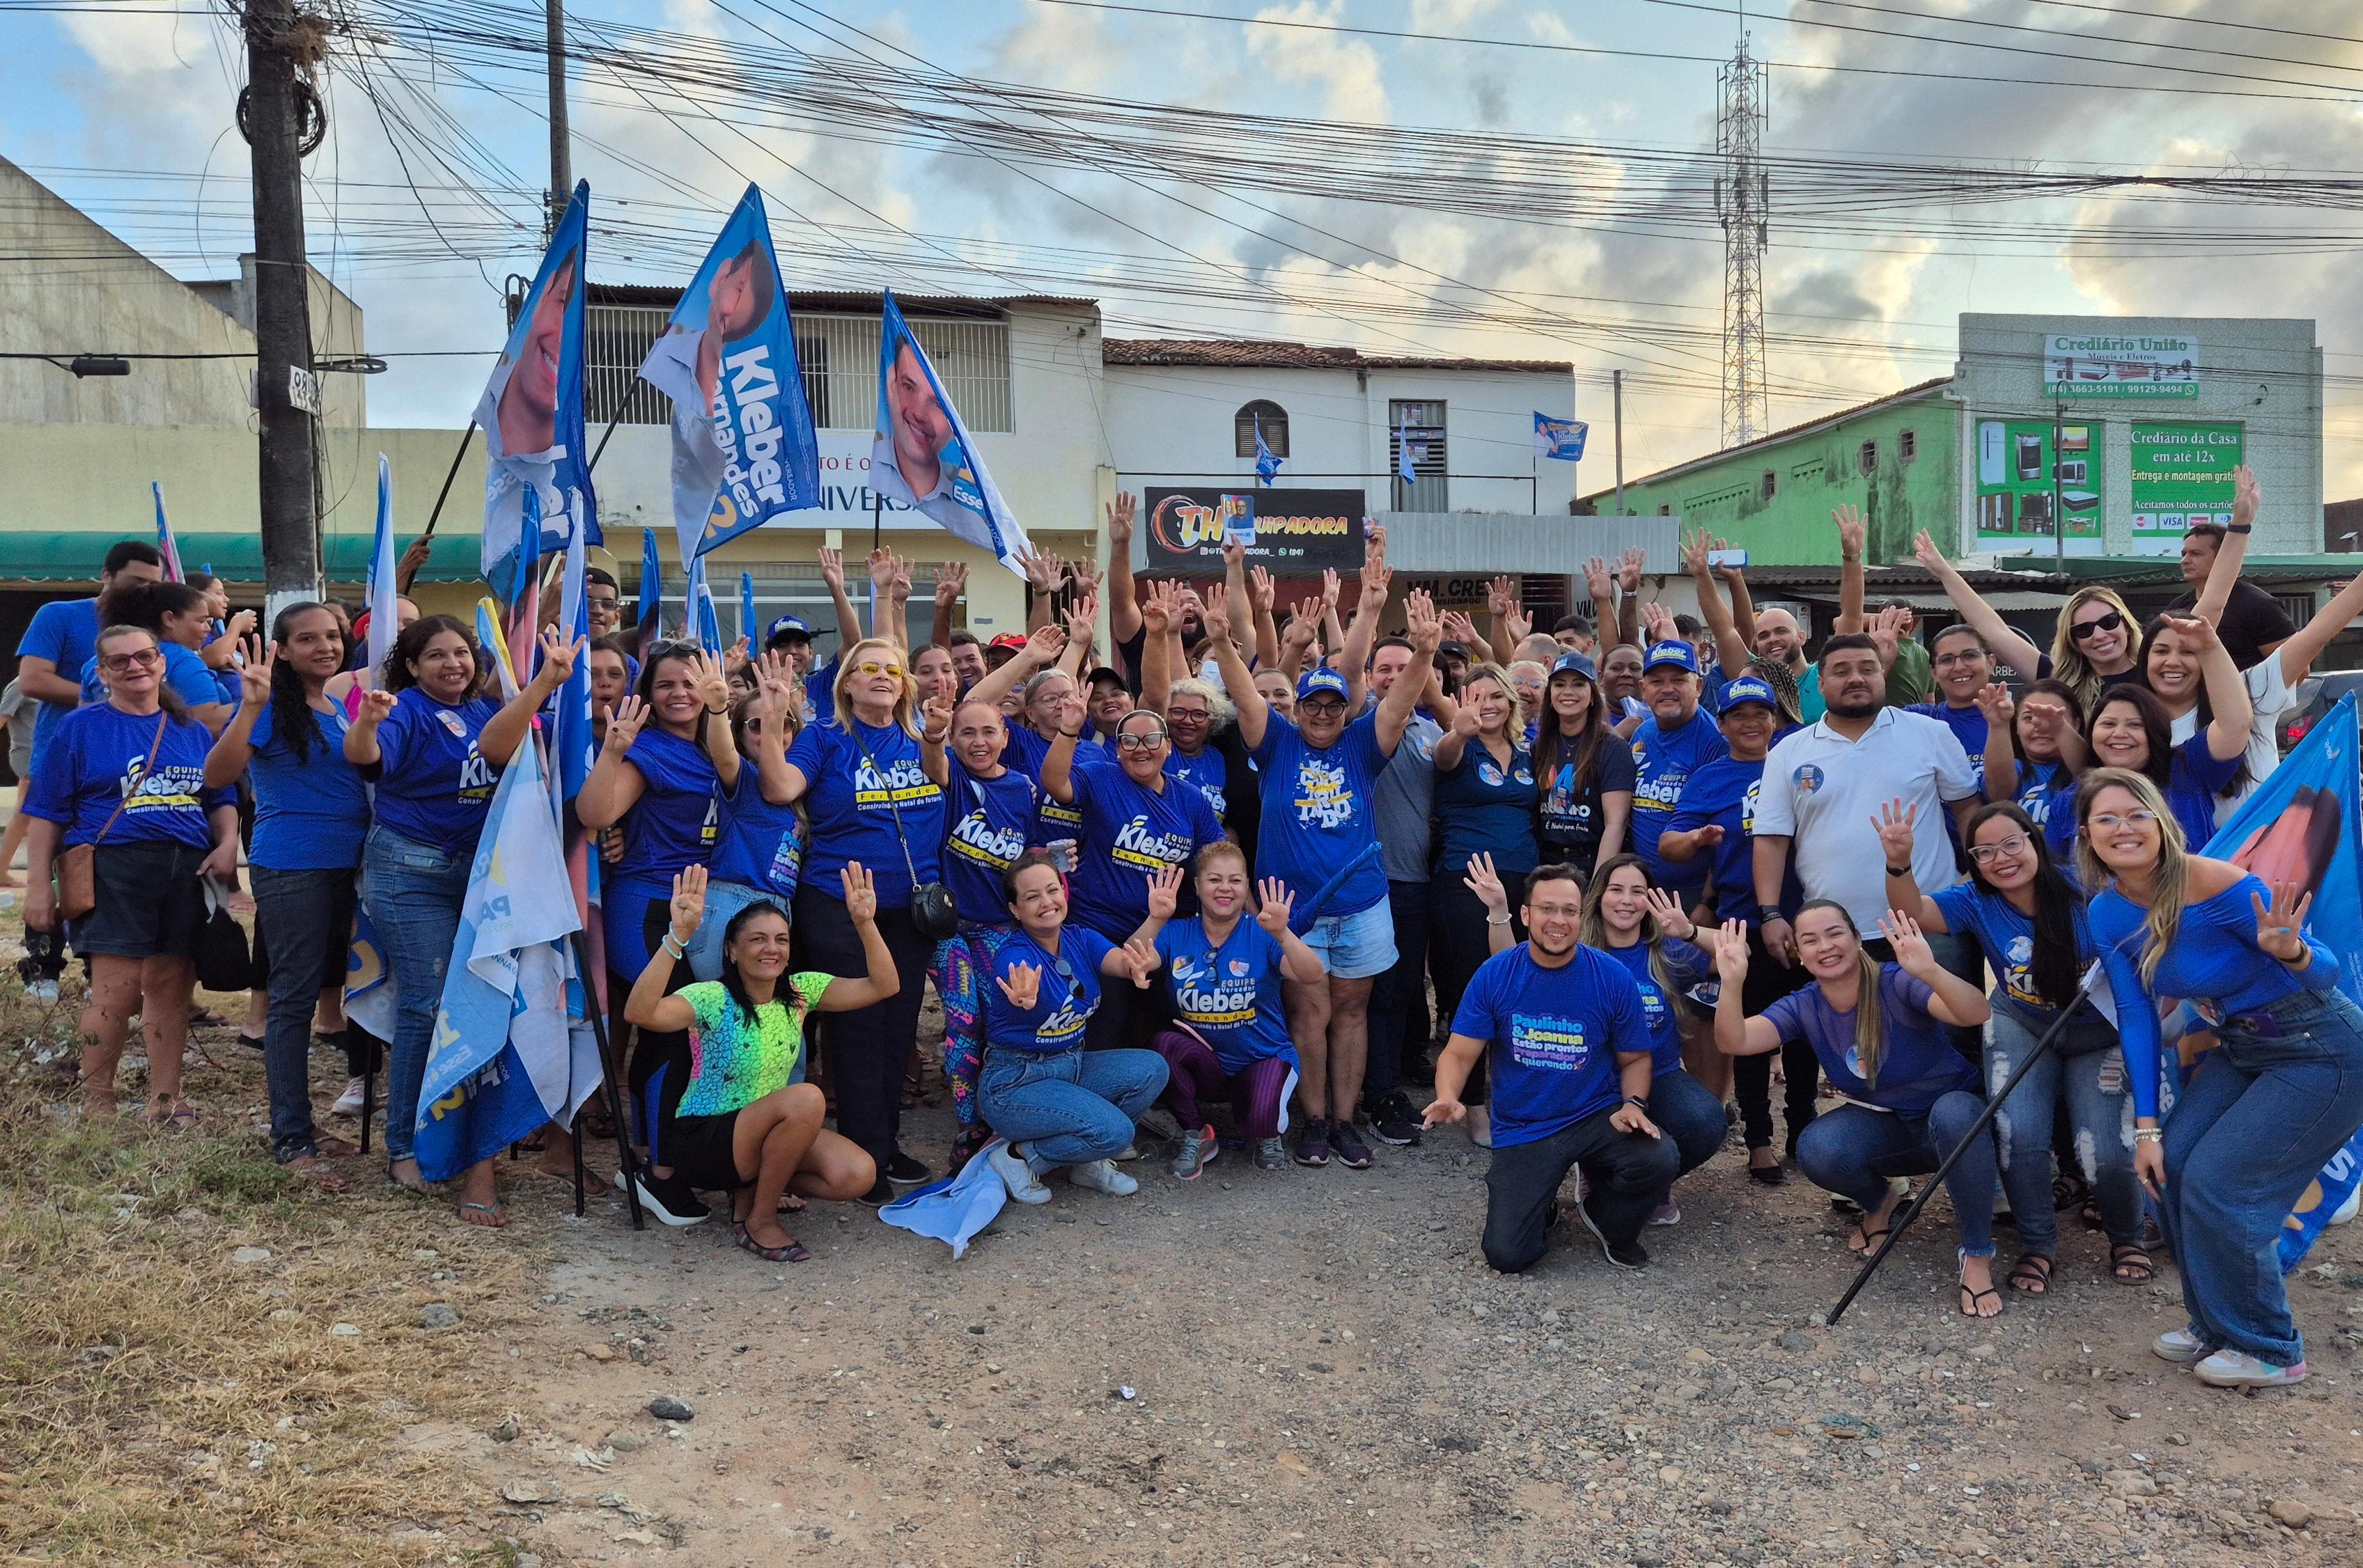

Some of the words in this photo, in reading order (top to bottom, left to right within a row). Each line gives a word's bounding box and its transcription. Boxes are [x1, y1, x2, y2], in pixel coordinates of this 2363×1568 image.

[2054, 337, 2135, 351] Crediário
[2139, 338, 2188, 352] União
[2088, 352, 2117, 361] Móveis
[2048, 384, 2067, 394] (84)
[2071, 384, 2119, 393] 3663-5191
[2128, 385, 2182, 394] 99129-9494
[725, 344, 786, 505] Kleber
[2131, 430, 2187, 444] Crediário
[2191, 432, 2205, 444] da
[2208, 432, 2237, 444] Casa
[845, 453, 854, 470] É
[2174, 450, 2192, 462] até
[2196, 450, 2215, 462] 12x
[784, 457, 798, 502] VEREADOR
[2132, 469, 2162, 483] Entrega
[2164, 473, 2169, 481] e
[2171, 471, 2213, 484] montagem
[953, 485, 984, 510] Esse
[2134, 500, 2174, 510] Aceitamos
[2176, 500, 2197, 510] todos
[1254, 516, 1348, 535] UIPADORA
[2162, 517, 2183, 526] VISA
[1289, 547, 1304, 556] (84)
[1651, 649, 1687, 658] Kleber
[1308, 675, 1343, 686] Kleber
[1729, 683, 1766, 696] Kleber
[1040, 817, 1073, 828] Construindo
[953, 814, 1024, 861] Kleber
[1114, 823, 1190, 863] Kleber
[1164, 832, 1192, 845] EQUIPE
[1112, 857, 1144, 871] Construindo
[1222, 977, 1256, 987] EQUIPE
[1222, 985, 1256, 994] Vereador
[1176, 988, 1257, 1012] Kleber
[1187, 1011, 1254, 1021] ernandes
[1512, 1013, 1583, 1033] Paulinho
[1035, 1032, 1074, 1044] Construindo
[1512, 1037, 1543, 1050] Estão
[1544, 1042, 1588, 1053] prontos
[1513, 1046, 1576, 1062] Preparados
[1514, 1053, 1522, 1063] E
[1521, 1057, 1573, 1070] querendo
